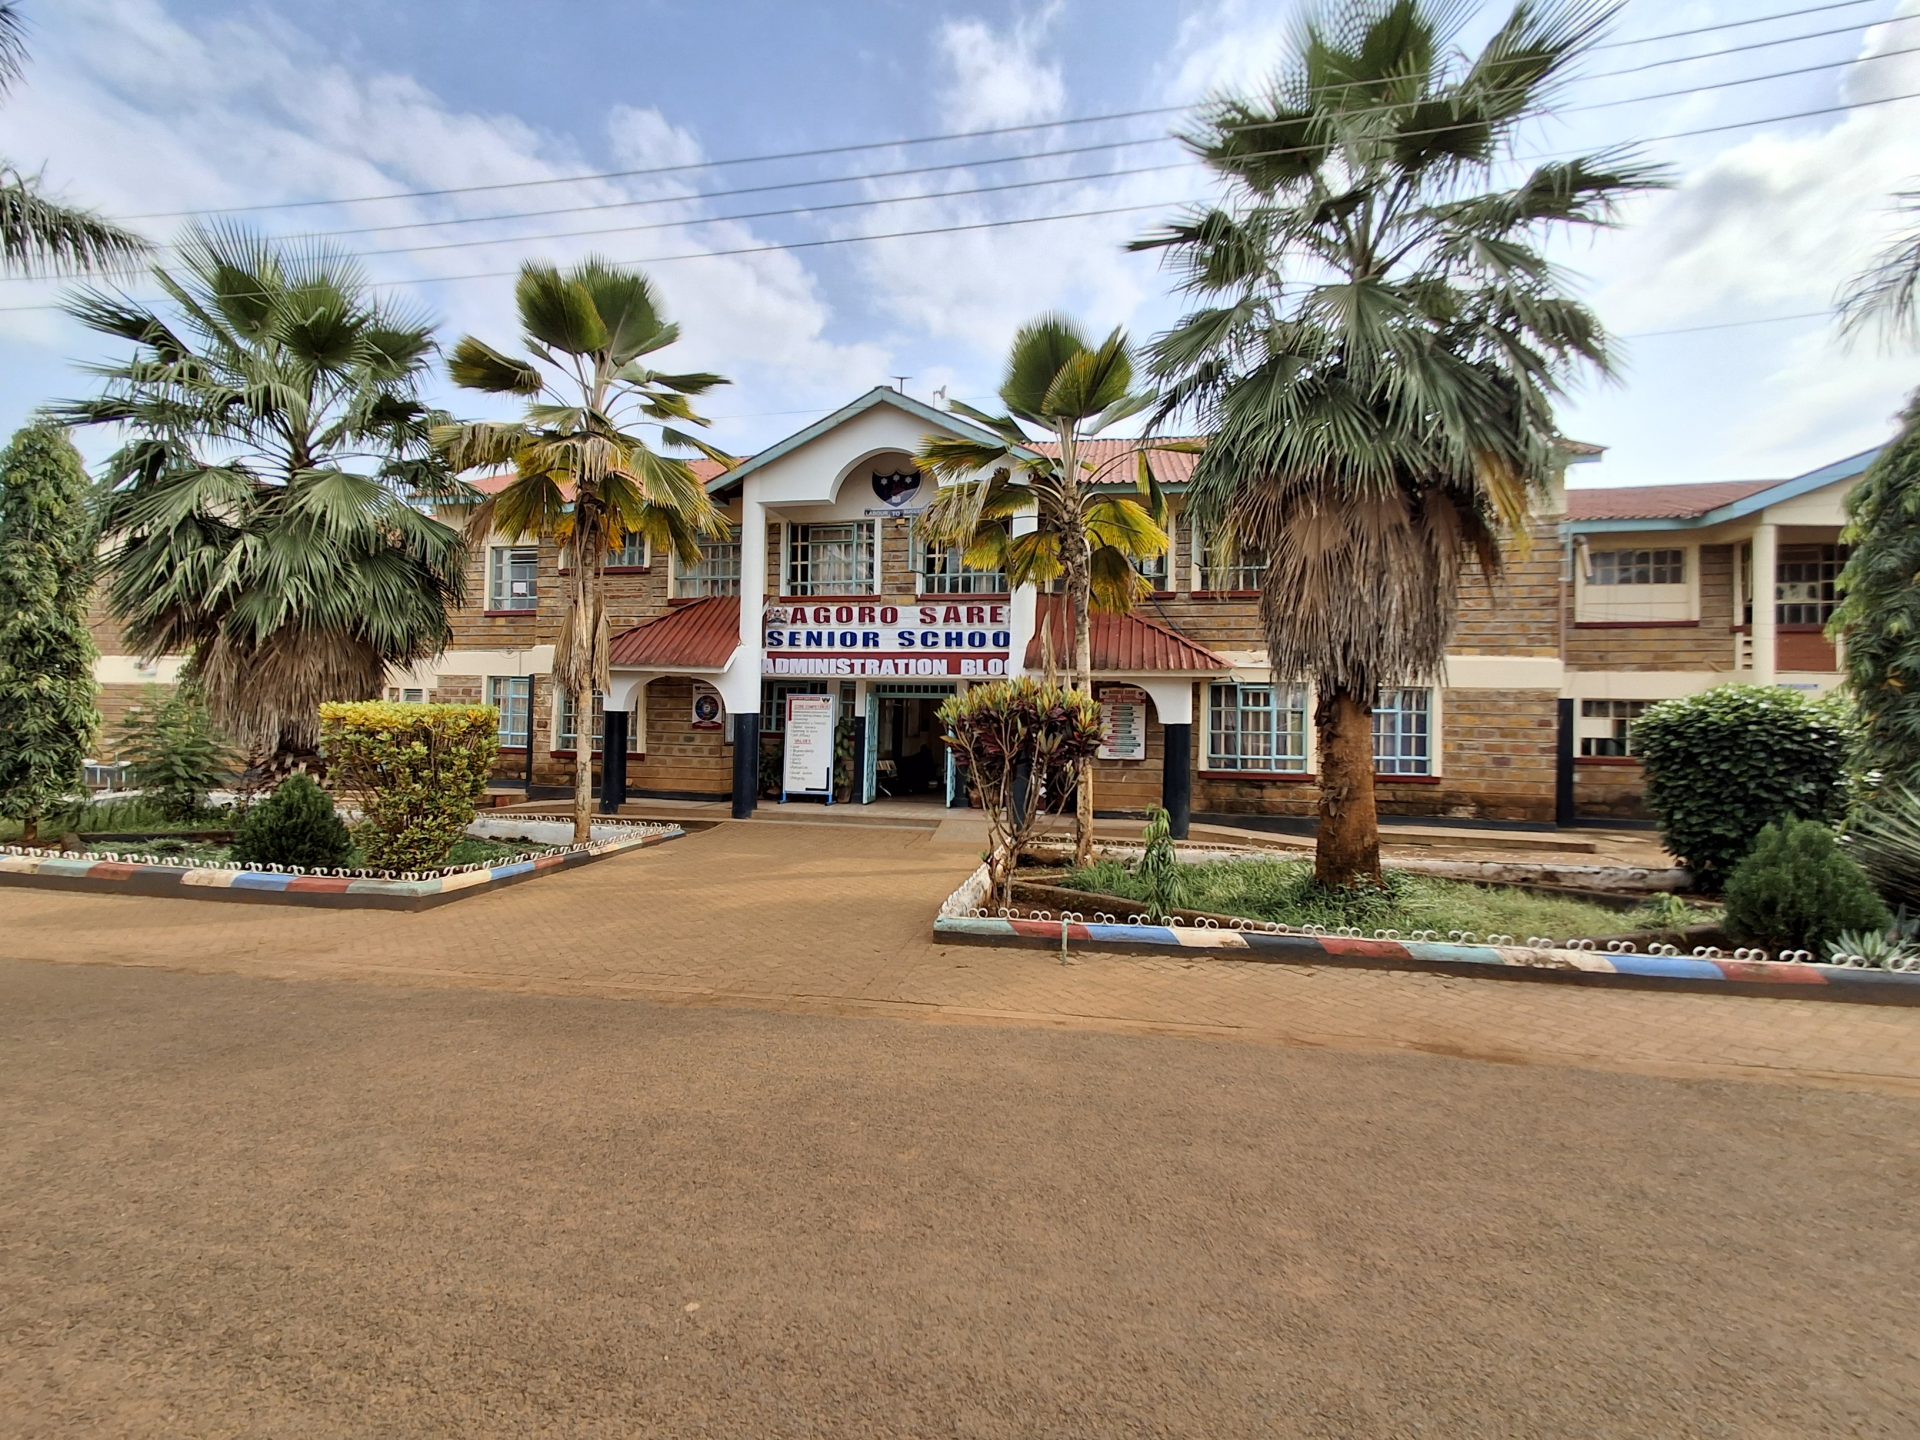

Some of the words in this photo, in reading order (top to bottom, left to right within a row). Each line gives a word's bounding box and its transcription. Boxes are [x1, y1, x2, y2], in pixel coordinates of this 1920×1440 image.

[790, 606, 898, 624] AGORO
[919, 606, 1003, 624] SARE
[767, 630, 880, 648] SENIOR
[761, 658, 948, 675] ADMINISTRATION
